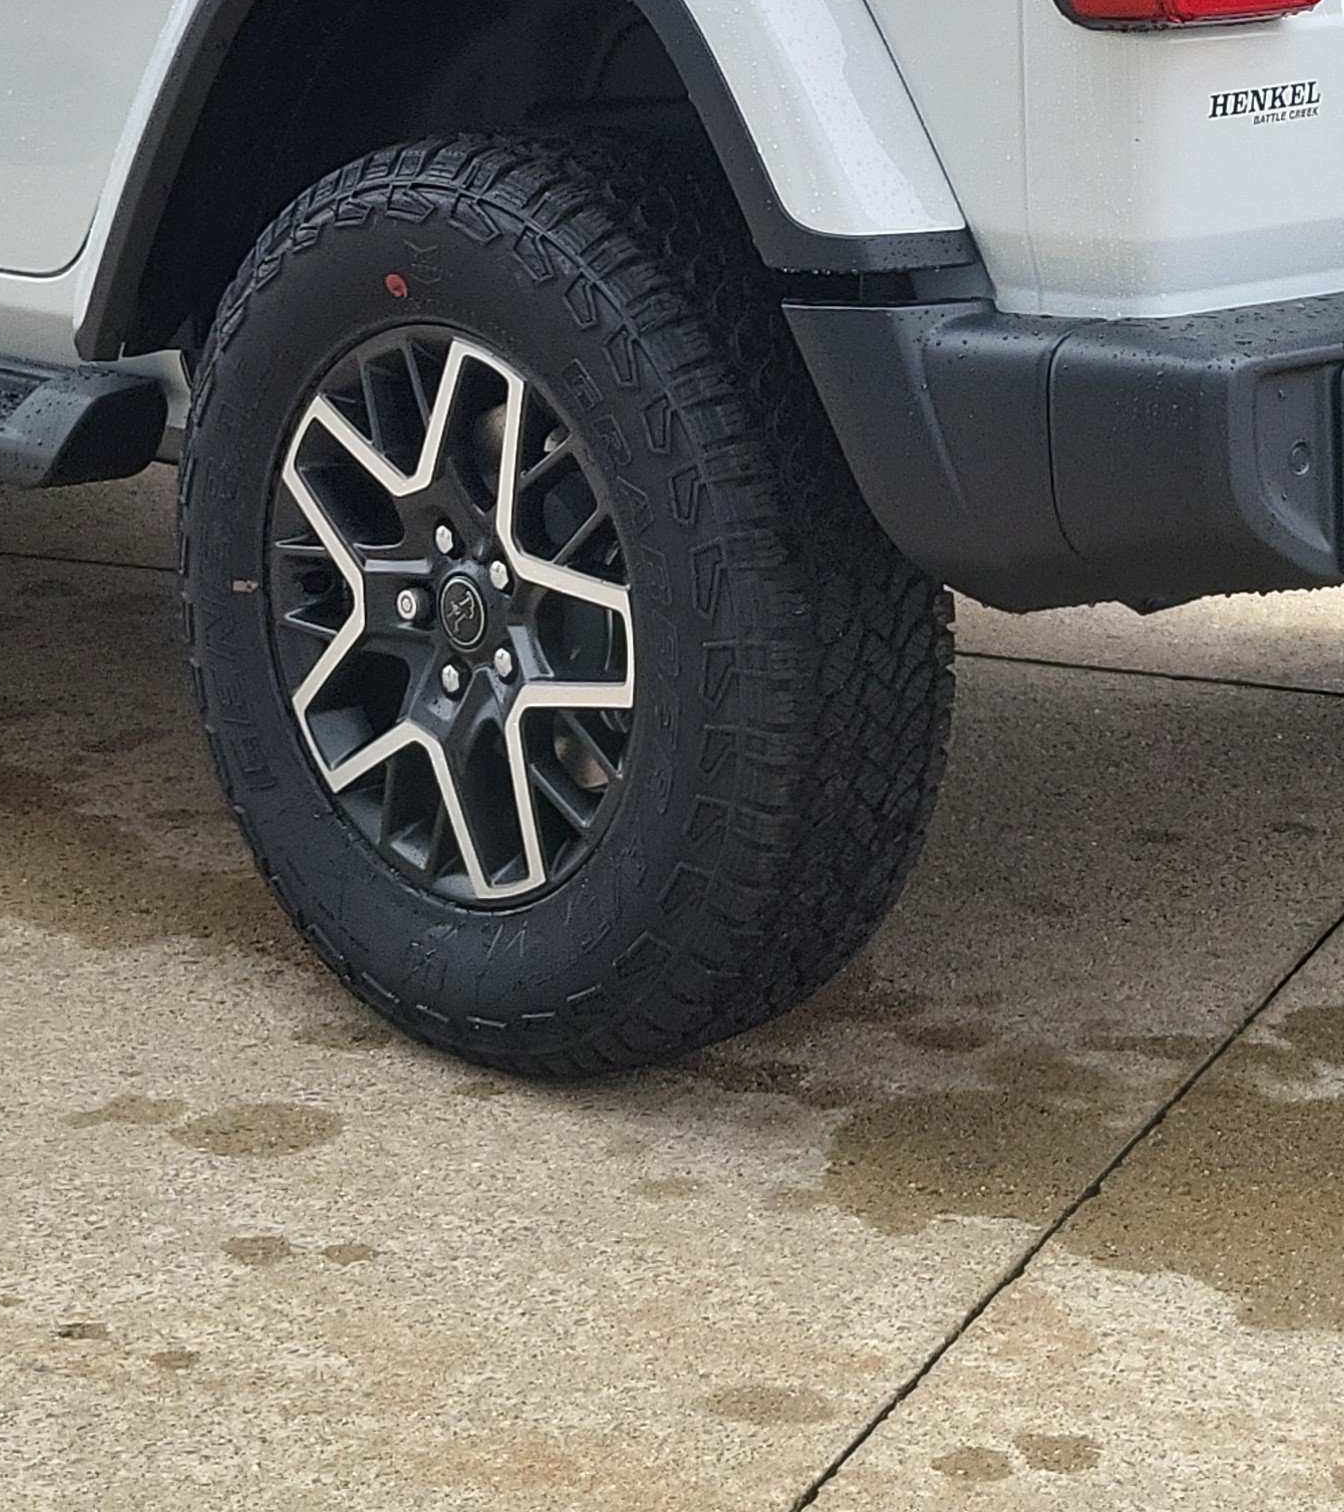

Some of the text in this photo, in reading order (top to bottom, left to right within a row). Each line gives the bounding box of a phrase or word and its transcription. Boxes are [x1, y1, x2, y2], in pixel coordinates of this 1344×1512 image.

[1208, 80, 1321, 119] HENKEL
[1253, 107, 1319, 125] BATTLE CREEK
